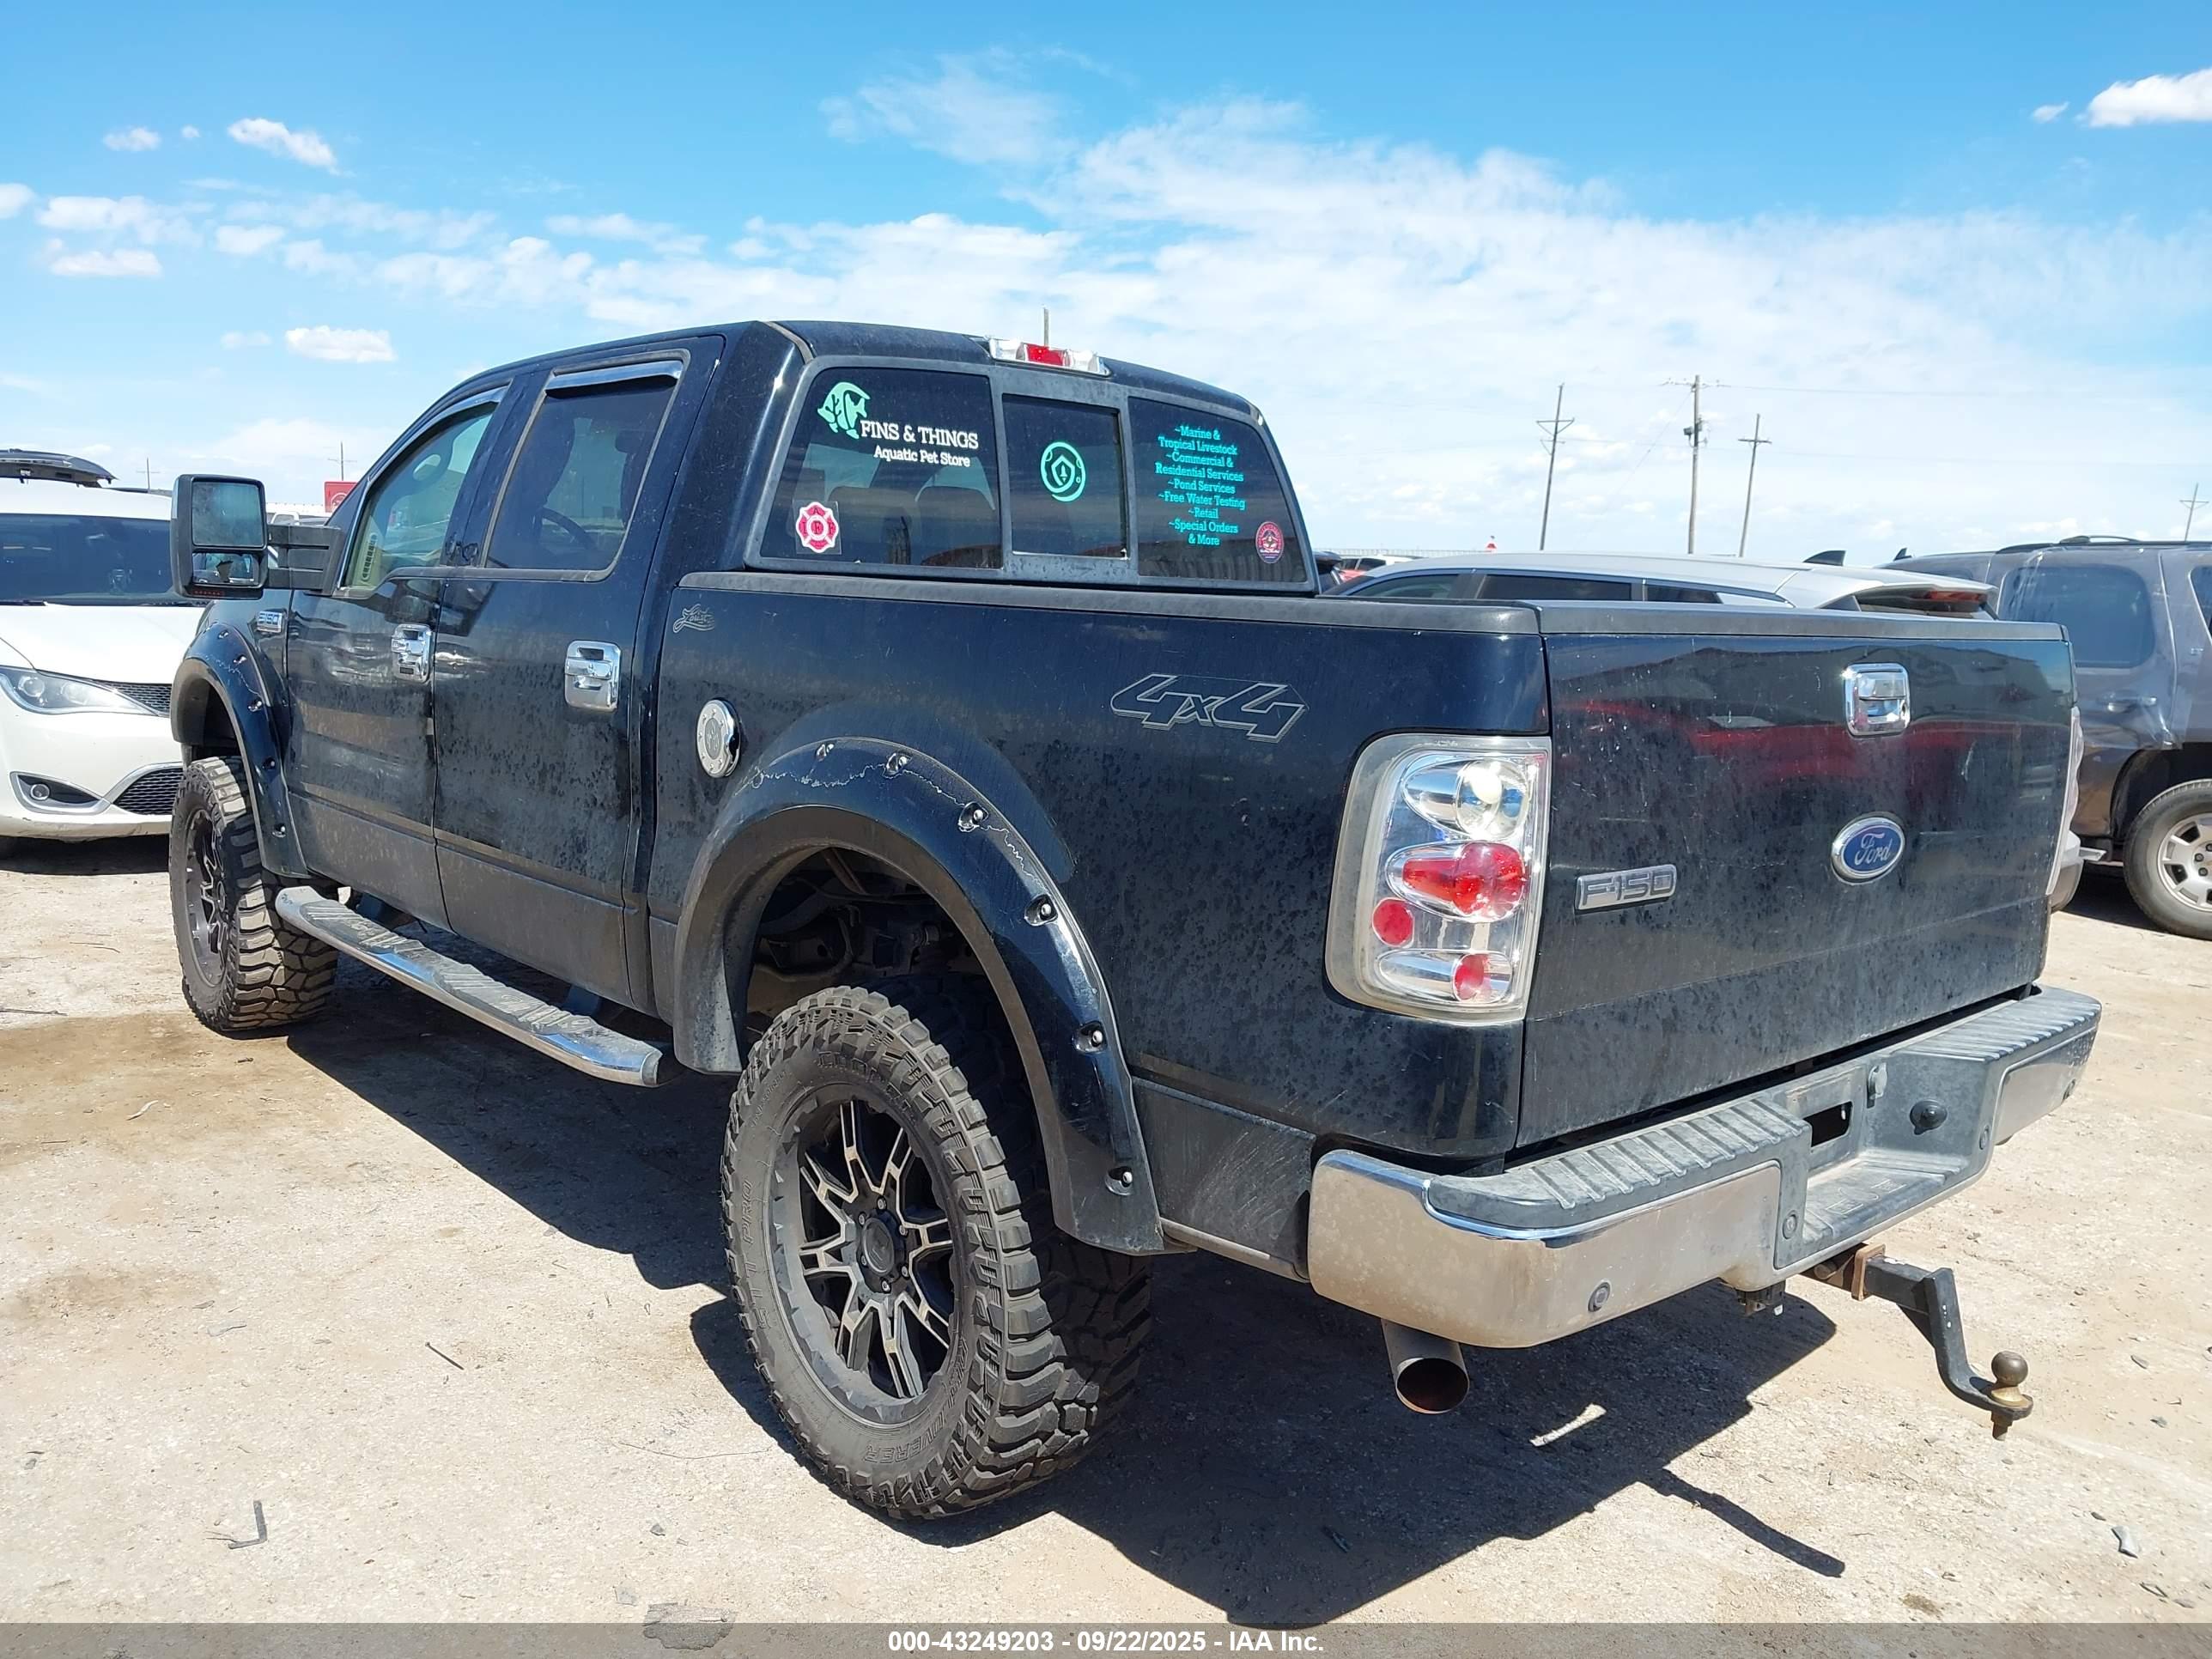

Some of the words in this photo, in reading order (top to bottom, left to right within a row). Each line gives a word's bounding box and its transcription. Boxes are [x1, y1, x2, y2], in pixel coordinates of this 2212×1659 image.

[860, 420, 900, 441] FINS
[903, 424, 916, 443] &
[917, 426, 979, 449] THINGS
[1212, 429, 1220, 440] &
[1158, 435, 1195, 451] Tropical
[1196, 441, 1237, 455] Livestock
[873, 445, 918, 462] Aquatic
[919, 449, 939, 464] Pet
[939, 452, 970, 467] Store
[1226, 457, 1234, 467] &
[1155, 462, 1206, 477] Residential
[1206, 468, 1244, 482] Services
[1198, 481, 1236, 495] Services
[1186, 493, 1212, 505] Water
[1213, 495, 1246, 511] Testing
[1208, 521, 1238, 533] Orders
[1188, 533, 1196, 544] &
[1197, 534, 1220, 546] More
[1855, 832, 1893, 866] Ford
